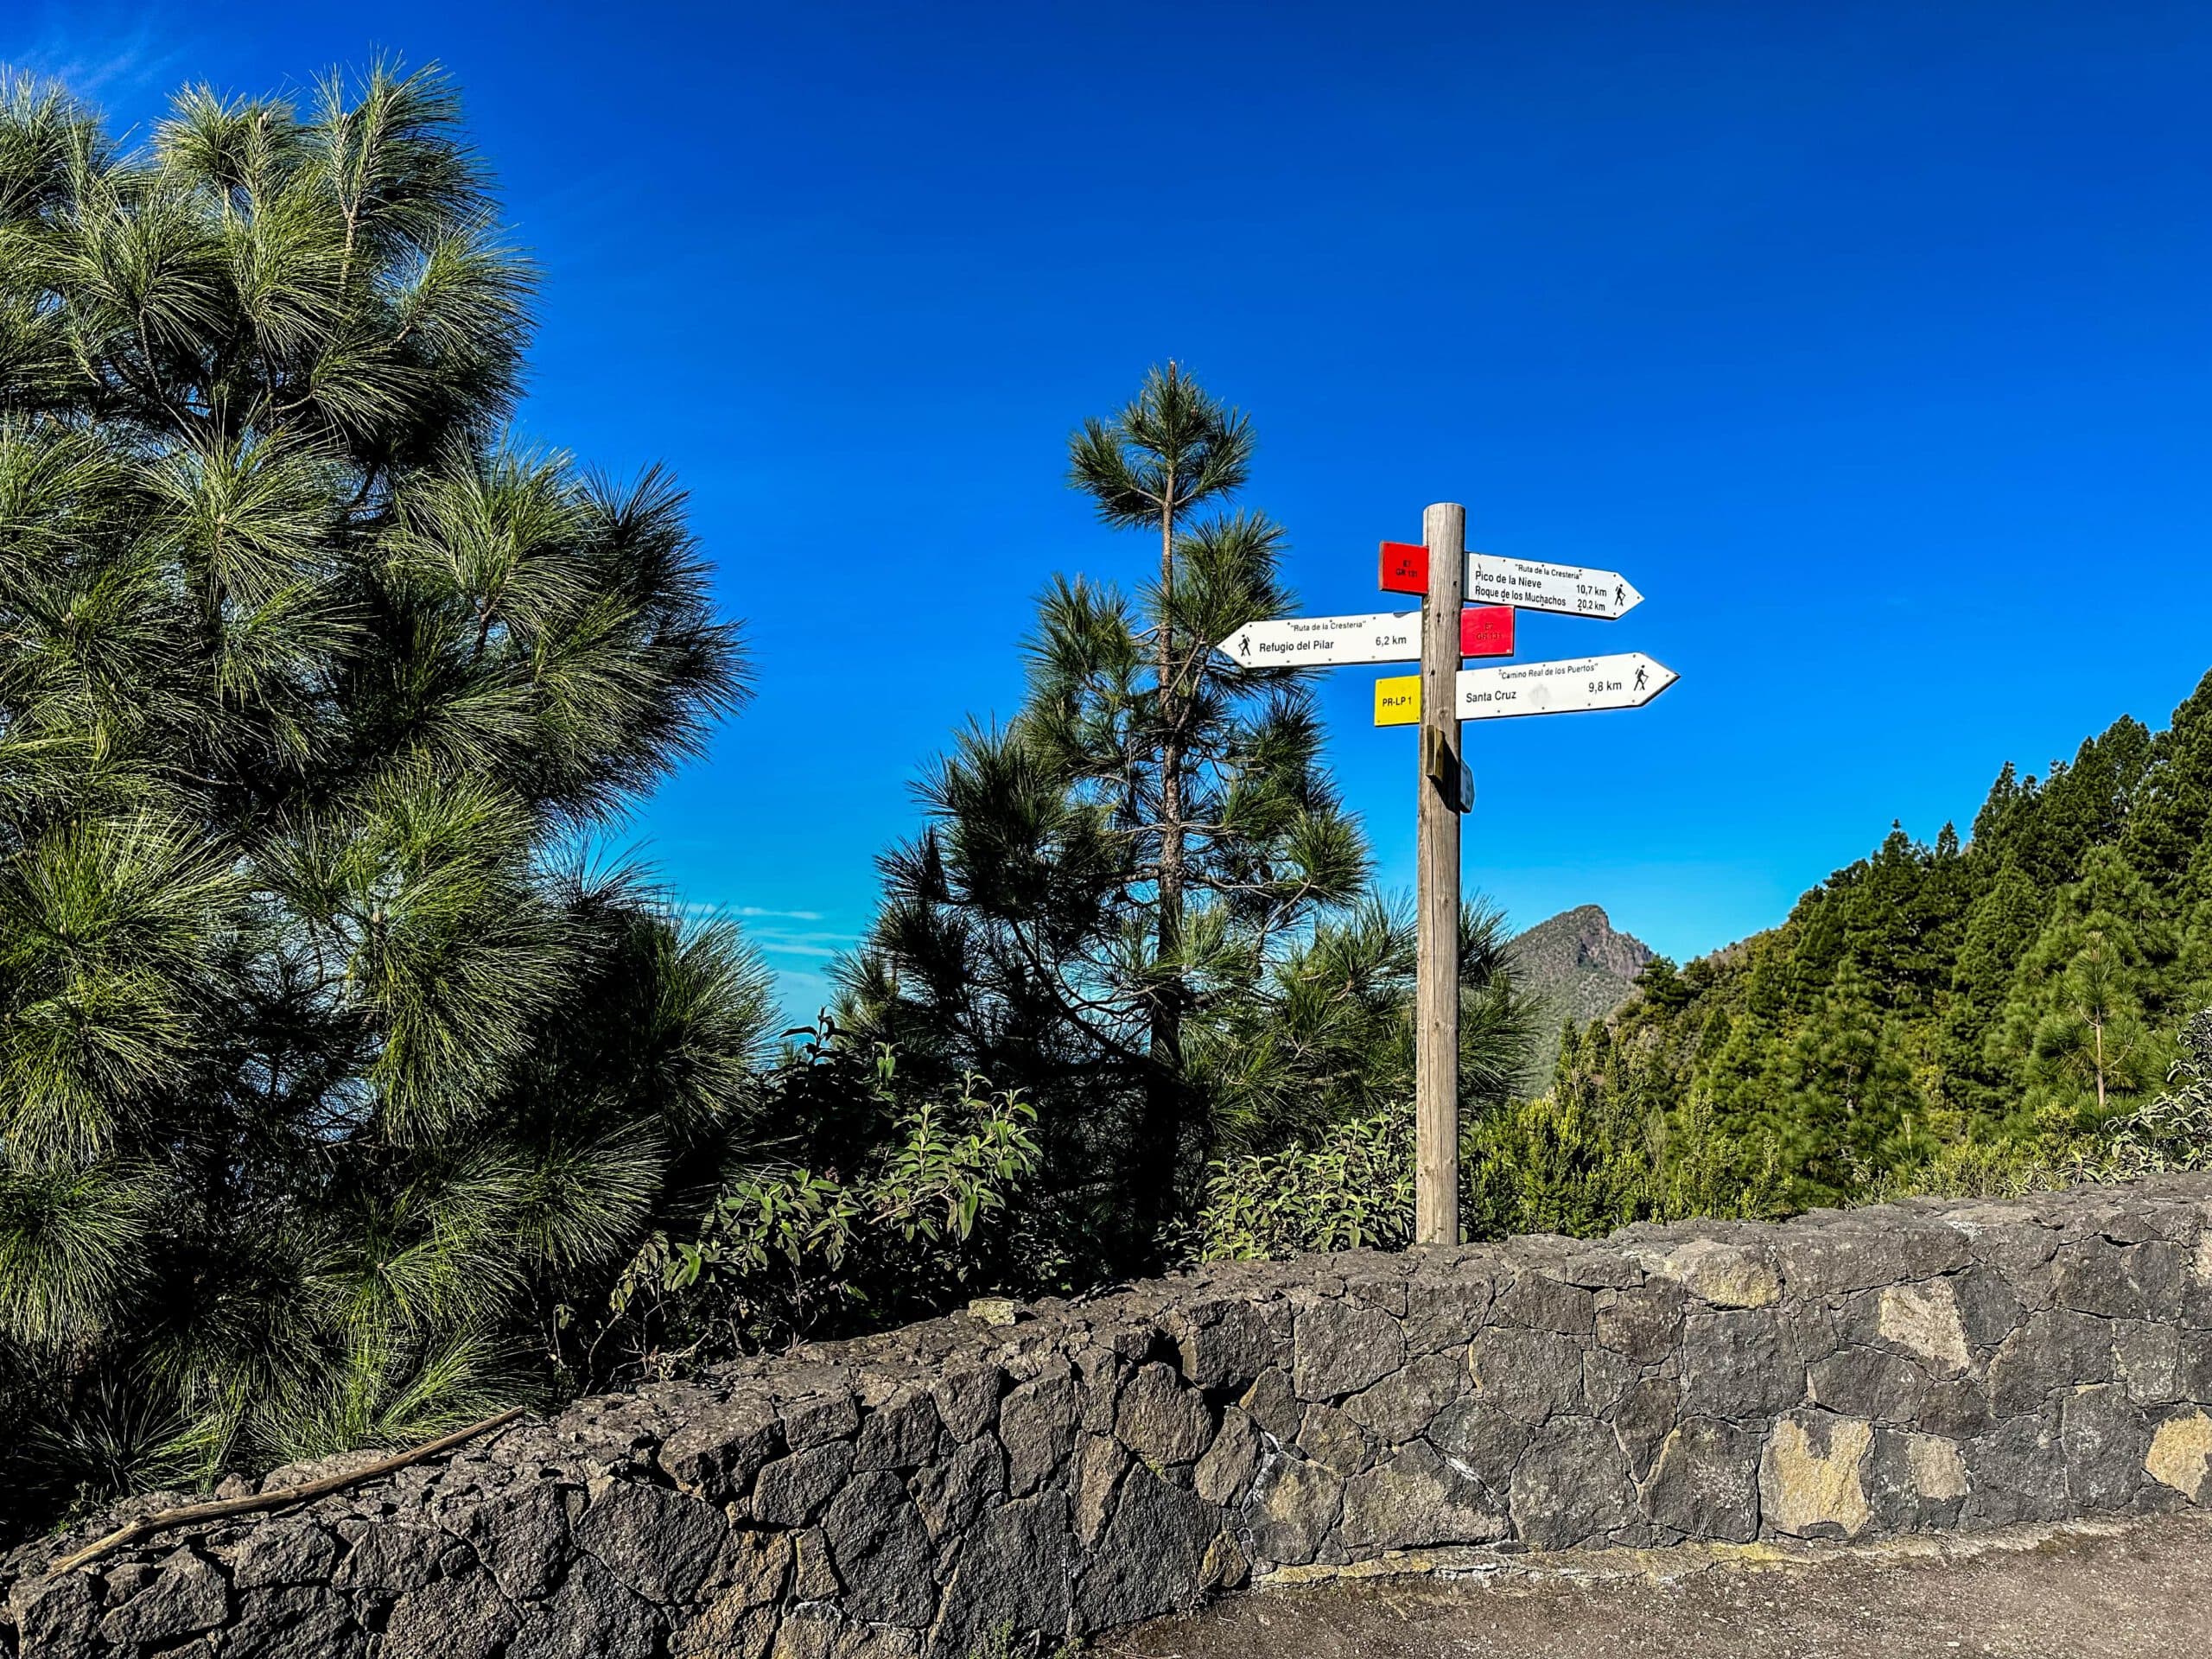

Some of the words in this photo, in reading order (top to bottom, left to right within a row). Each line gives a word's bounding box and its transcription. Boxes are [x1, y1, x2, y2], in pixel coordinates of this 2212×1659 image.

[1515, 563, 1533, 574] "Ruta
[1475, 572, 1493, 582] Pico
[1496, 574, 1507, 583] de
[1509, 575, 1516, 585] la
[1519, 576, 1541, 588] Nieve
[1577, 585, 1592, 595] 10,7
[1594, 587, 1607, 597] km
[1475, 585, 1498, 598] Roque
[1501, 588, 1510, 599] de
[1512, 589, 1522, 601] los
[1525, 593, 1566, 606] Muchachos
[1578, 599, 1592, 609] 20,2
[1594, 601, 1605, 611] km
[1291, 624, 1310, 632] "Ruta
[1260, 641, 1294, 654] Refugio
[1297, 639, 1311, 651] del
[1313, 639, 1334, 650] Pilar
[1376, 636, 1389, 647] 6,2
[1392, 634, 1407, 645] km
[1529, 668, 1543, 677] Real
[1545, 667, 1554, 676] de
[1554, 666, 1566, 676] los
[1567, 663, 1599, 674] Puertos"
[1465, 693, 1492, 702] Santa
[1495, 691, 1516, 701] Cruz
[1588, 682, 1604, 693] 9,8
[1606, 681, 1622, 691] km
[1382, 696, 1406, 707] PR-LP
[1408, 696, 1412, 705] 1
